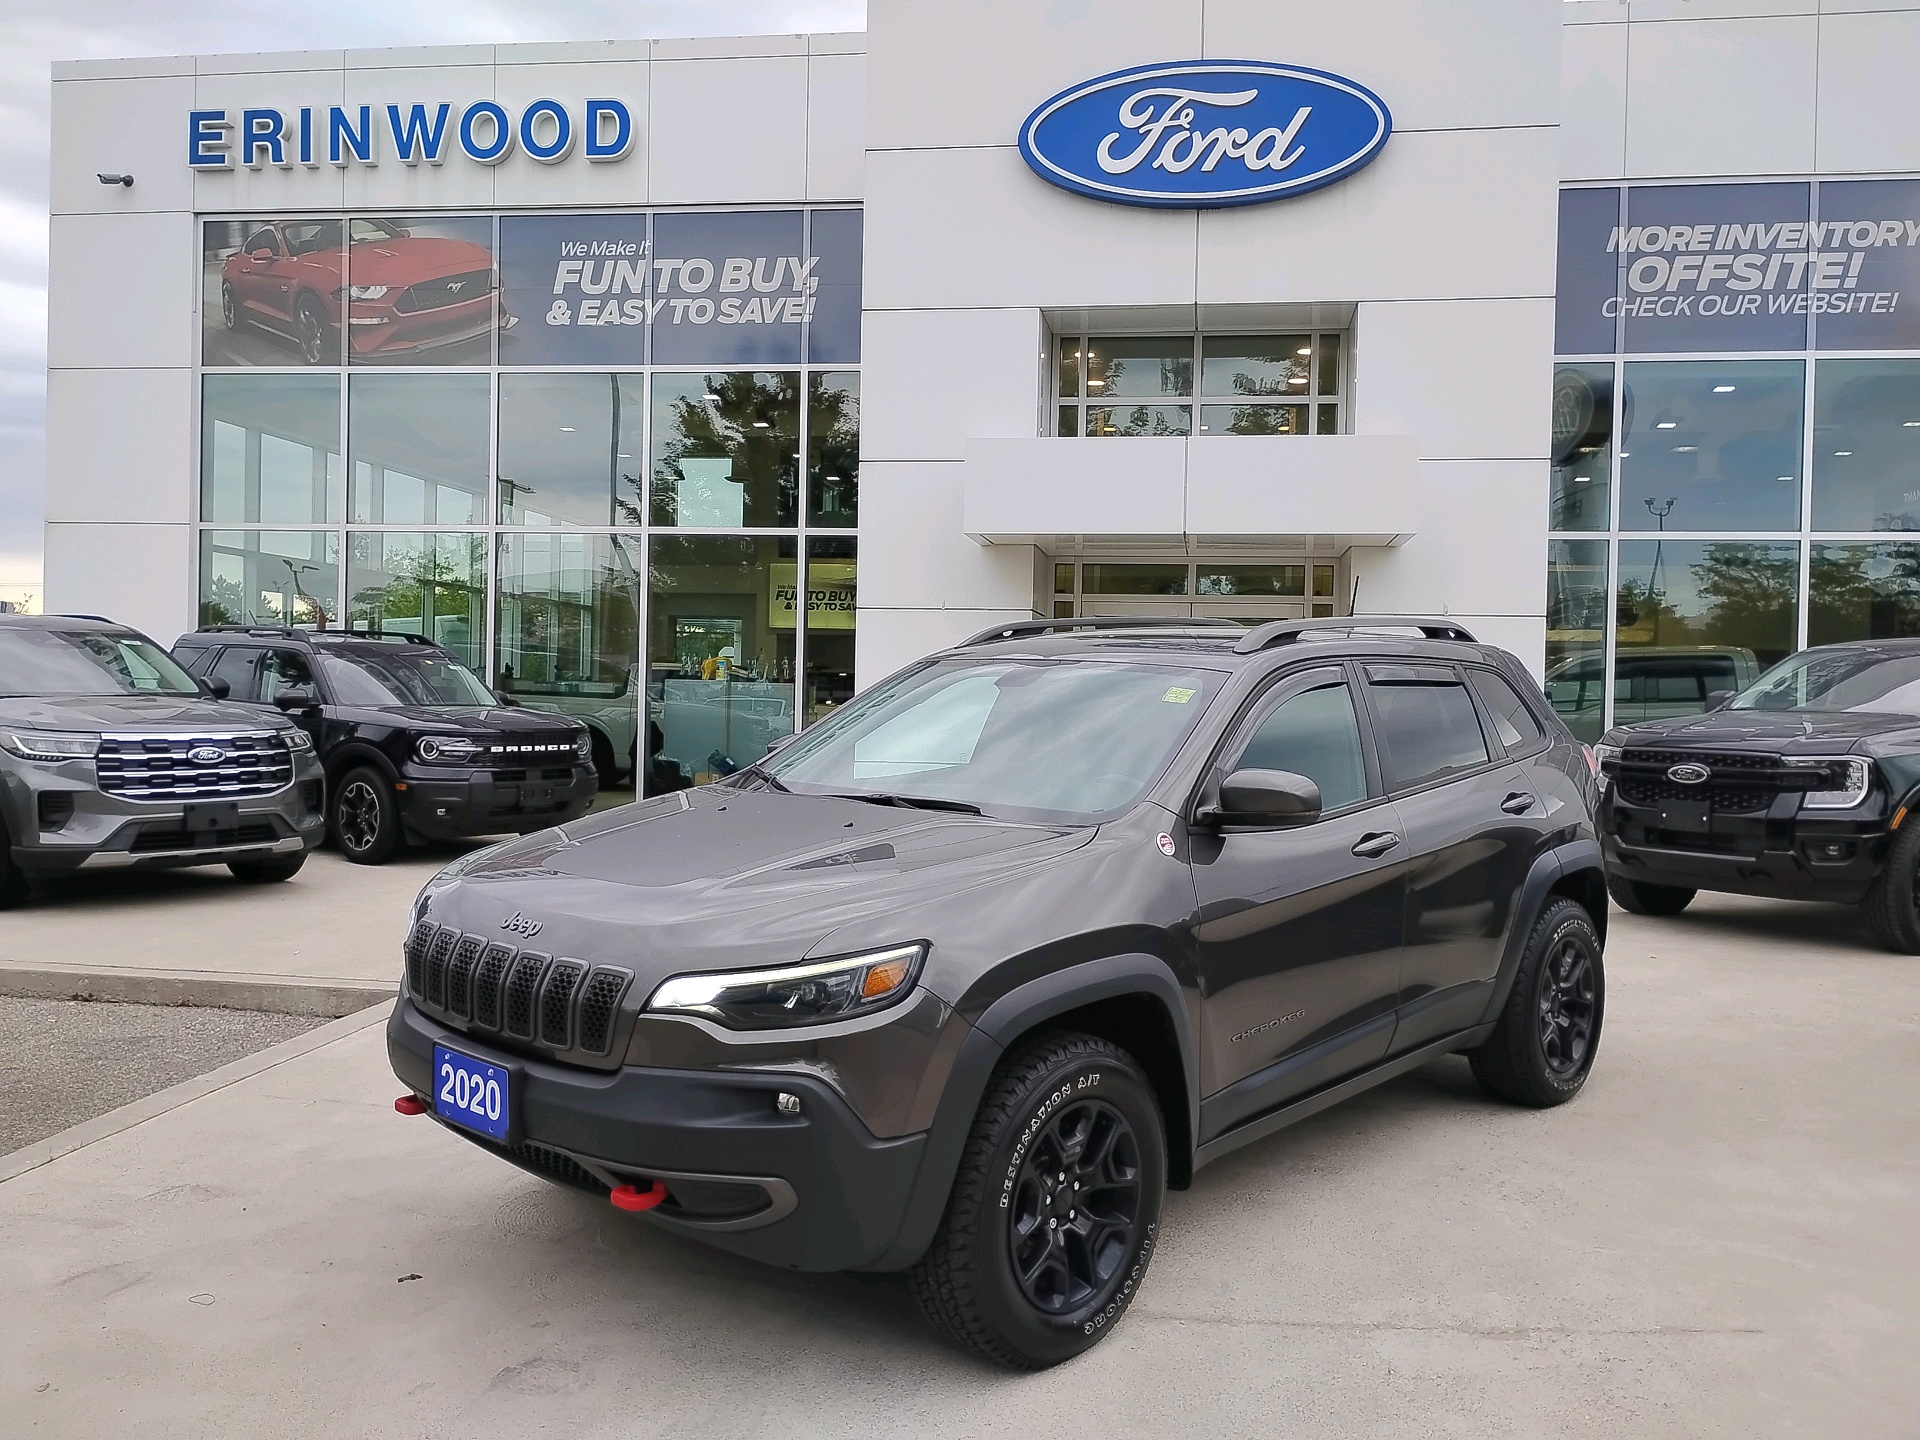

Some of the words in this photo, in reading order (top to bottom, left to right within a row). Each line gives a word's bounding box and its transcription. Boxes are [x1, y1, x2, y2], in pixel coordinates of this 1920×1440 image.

[187, 97, 637, 173] ERINWOOD
[1097, 87, 1314, 174] Ford
[560, 240, 587, 257] We
[590, 240, 637, 257] Make
[639, 238, 651, 256] It
[1605, 224, 1717, 254] MORE
[1714, 219, 1920, 251] INVENTORY
[552, 258, 649, 295] FUN
[654, 257, 715, 294] TO
[718, 255, 822, 295] BUY,
[1627, 251, 1867, 293] OFFSITE!
[545, 299, 573, 326] &
[576, 298, 666, 327] EASY
[669, 298, 716, 325] TO
[716, 296, 818, 325] SAVE!
[1600, 295, 1697, 319] CHECK
[1698, 293, 1765, 317] OUR
[1767, 291, 1900, 316] WEBSITE!
[775, 590, 798, 602] FU
[808, 590, 827, 602] TO
[783, 601, 793, 611] &
[823, 602, 838, 611] TO
[197, 750, 220, 760] Ford
[490, 744, 570, 753] BRONCO
[1676, 768, 1698, 780] Ford
[1230, 1008, 1305, 1043] CHEROKEE
[440, 1063, 501, 1121] 2020
[1000, 1083, 1071, 1208] DESTINATION
[1077, 1074, 1101, 1089] A/T
